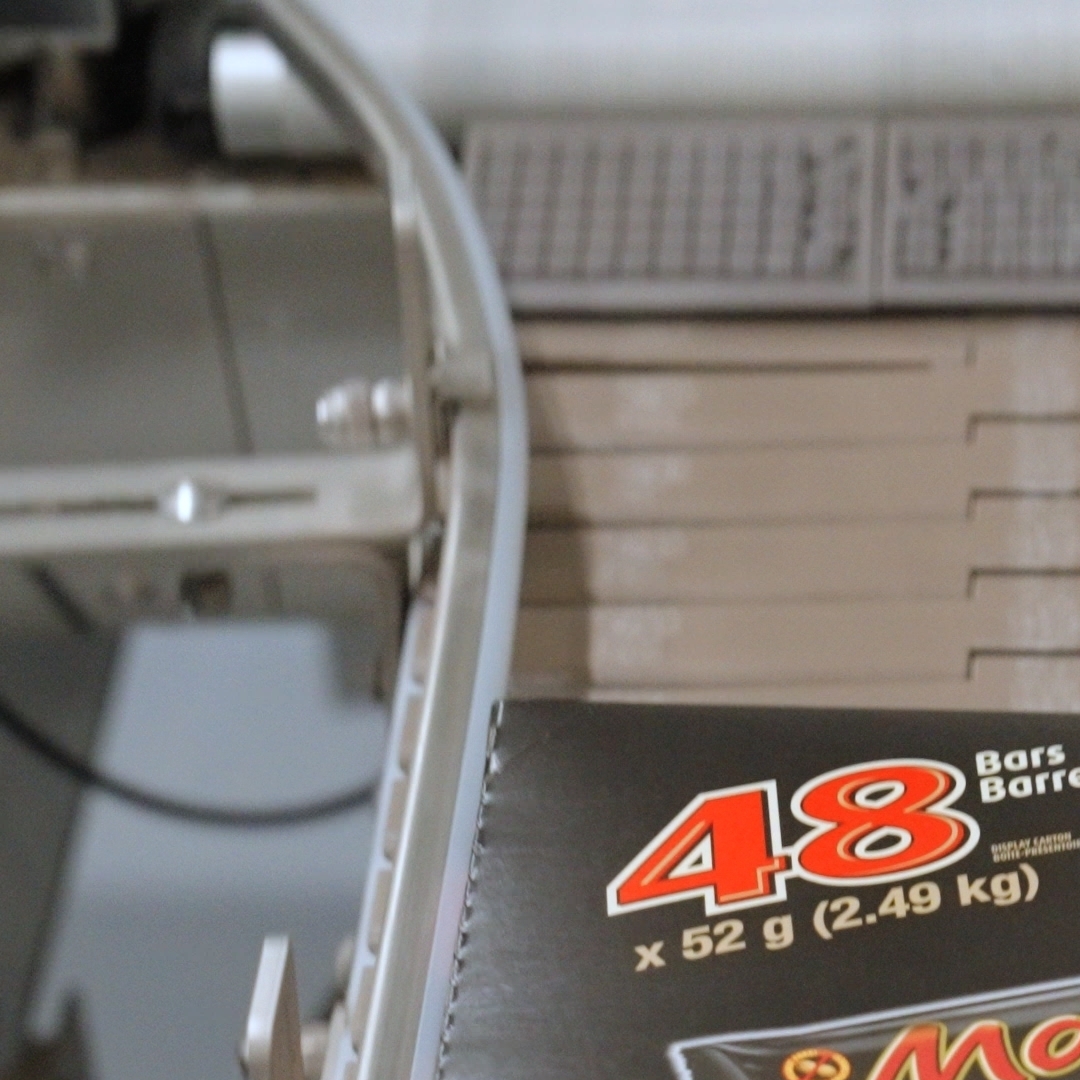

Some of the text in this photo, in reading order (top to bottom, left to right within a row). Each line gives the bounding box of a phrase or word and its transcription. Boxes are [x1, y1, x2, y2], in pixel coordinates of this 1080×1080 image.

[976, 743, 1065, 776] Bars
[607, 758, 980, 916] 48
[634, 863, 1040, 973] x 52 g (2.49 kg)
